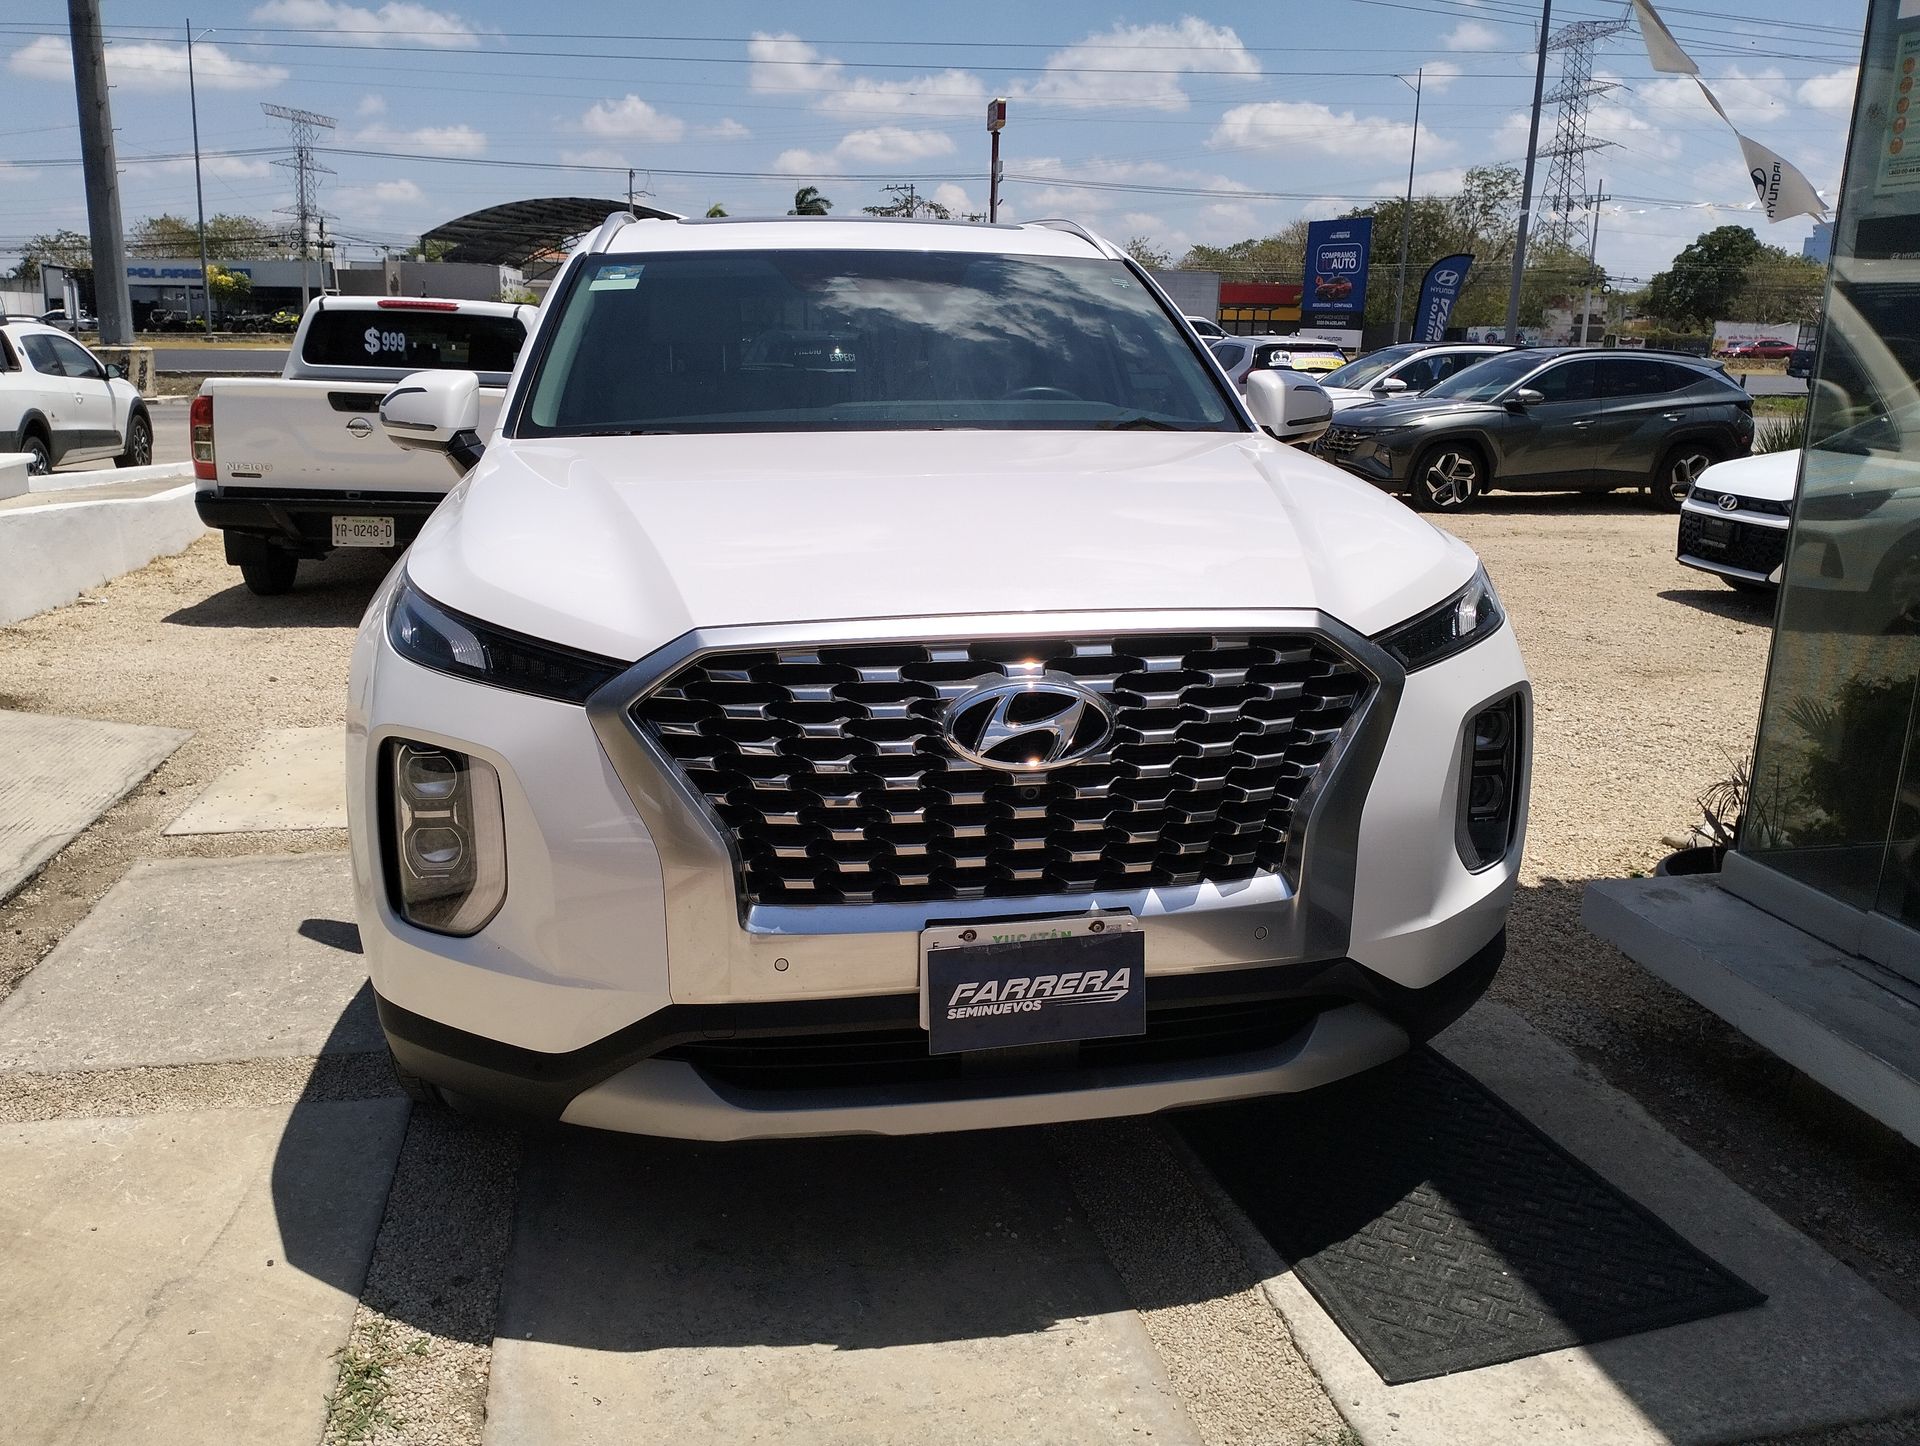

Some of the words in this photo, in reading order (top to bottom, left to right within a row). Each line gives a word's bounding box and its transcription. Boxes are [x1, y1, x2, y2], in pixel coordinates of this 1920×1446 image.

[1766, 161, 1781, 218] HYUNDAI
[1321, 251, 1357, 259] COMPRAMOS
[1331, 258, 1357, 269] AUTO
[364, 327, 406, 355] $999
[334, 524, 392, 537] YR-0248-D
[949, 967, 1131, 1006] FARRERA
[946, 1000, 1042, 1020] SEMINUEVOS
